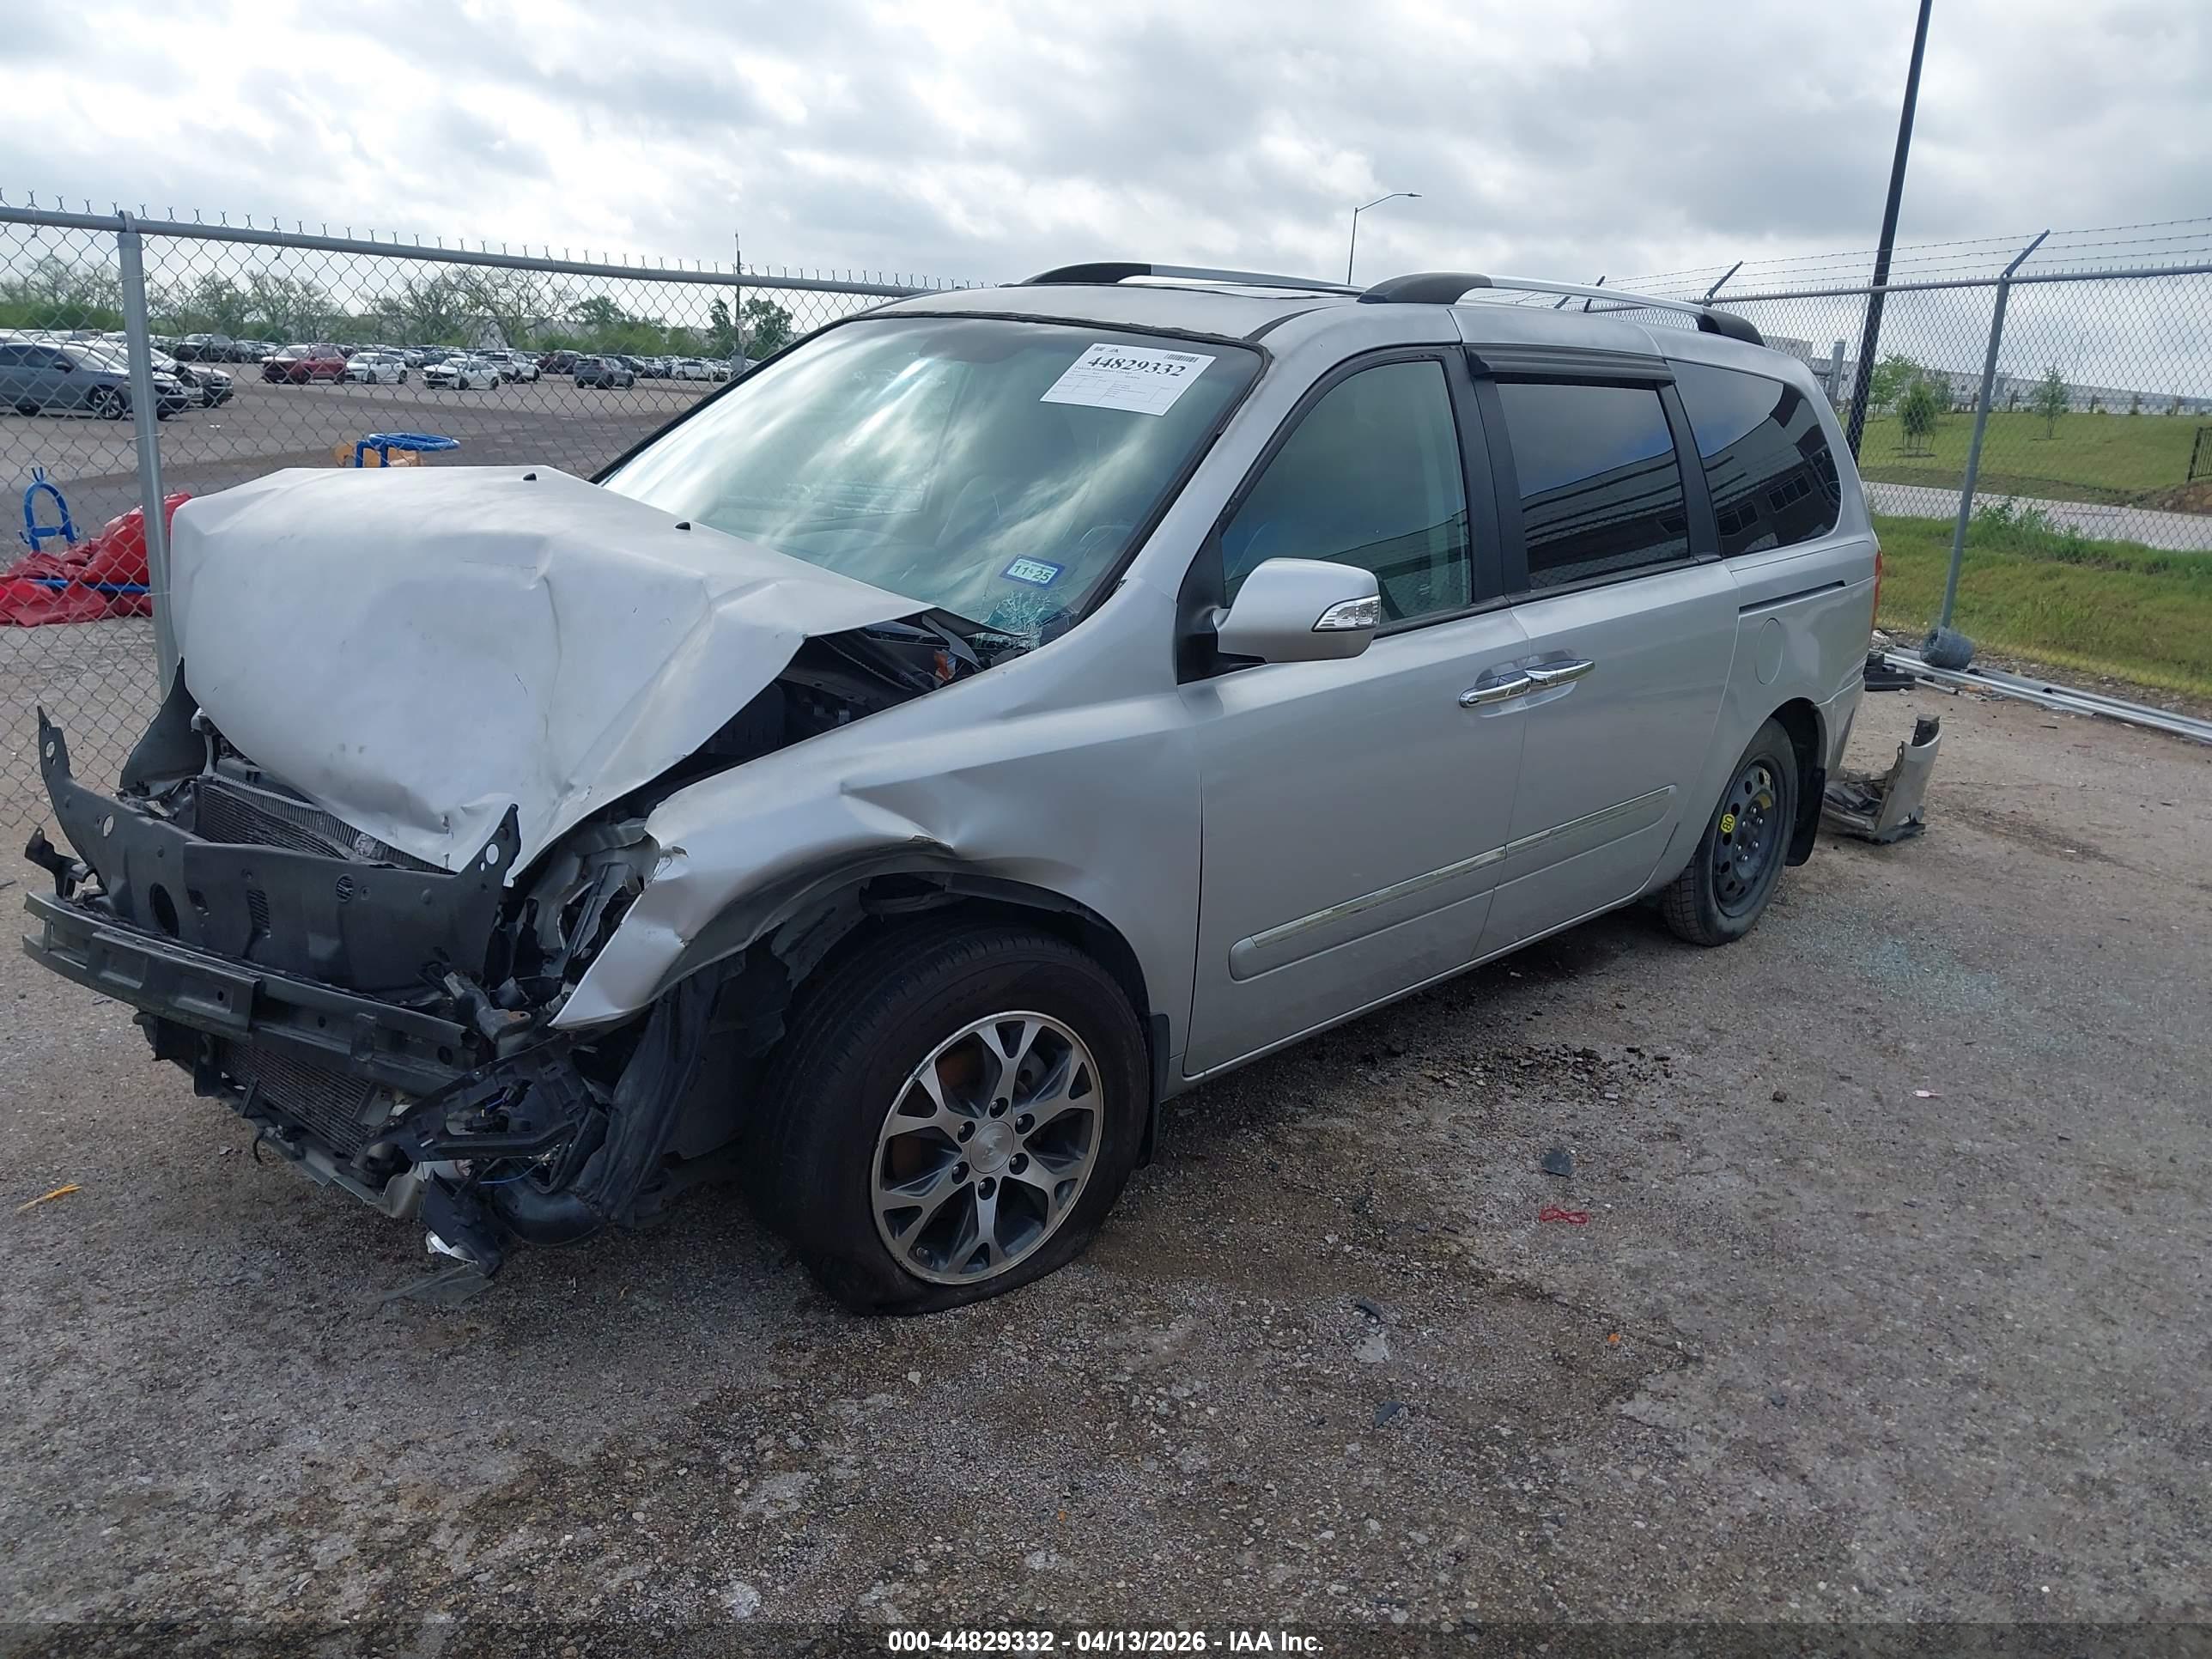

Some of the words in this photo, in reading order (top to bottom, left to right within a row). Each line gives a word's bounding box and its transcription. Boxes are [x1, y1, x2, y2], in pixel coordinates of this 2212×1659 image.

[1087, 356, 1187, 377] 44829332
[1013, 565, 1030, 575] 11
[1031, 569, 1052, 581] 25
[1723, 816, 1734, 830] 80
